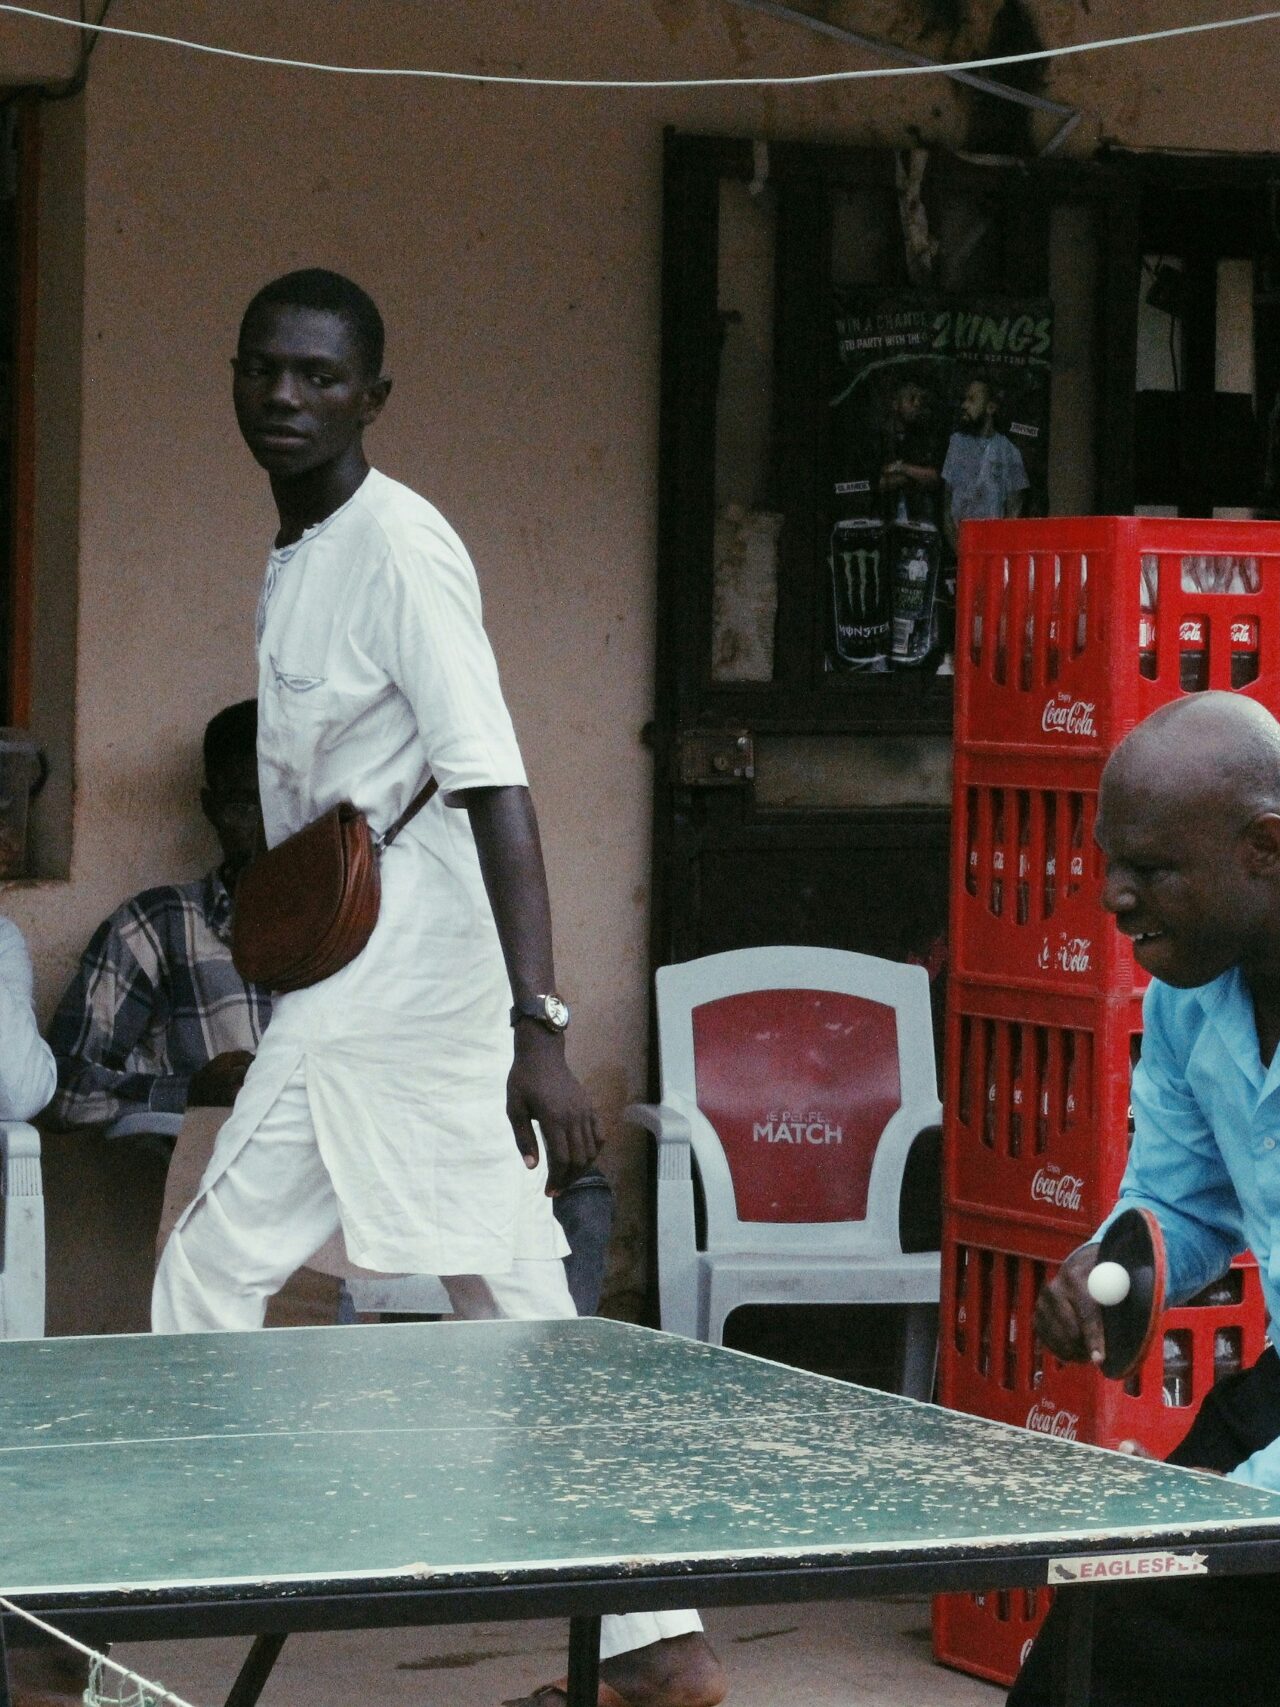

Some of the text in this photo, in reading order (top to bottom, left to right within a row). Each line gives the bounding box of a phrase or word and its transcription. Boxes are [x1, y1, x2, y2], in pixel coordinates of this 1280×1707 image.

[856, 336, 884, 351] PARTY
[885, 334, 905, 348] WITH
[907, 332, 921, 345] THE
[753, 1122, 843, 1145] MATCH
